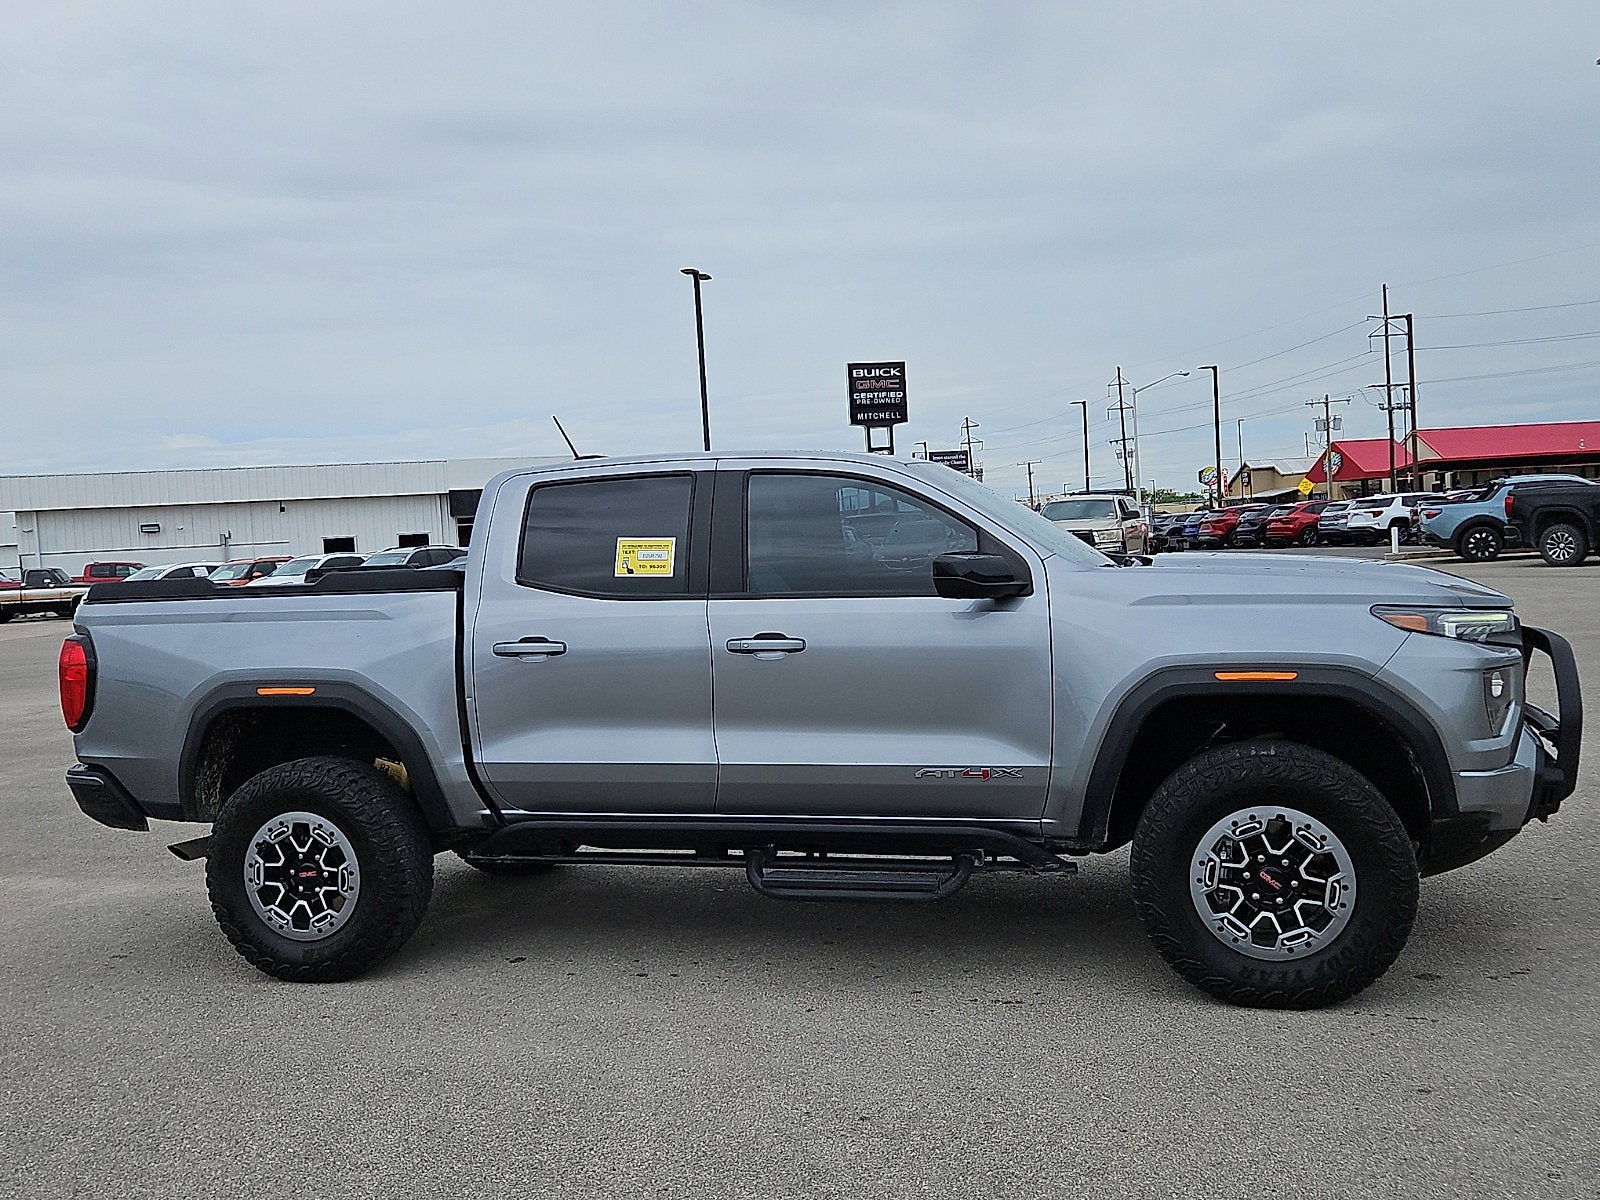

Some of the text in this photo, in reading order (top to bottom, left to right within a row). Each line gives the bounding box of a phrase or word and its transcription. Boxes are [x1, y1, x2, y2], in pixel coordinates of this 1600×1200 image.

[852, 368, 901, 377] BUICK
[856, 379, 899, 389] GMC
[856, 397, 901, 405] PRE-OWNED
[857, 412, 901, 420] MITCHELL
[915, 767, 1023, 781] AT4X
[1259, 870, 1283, 890] GMC
